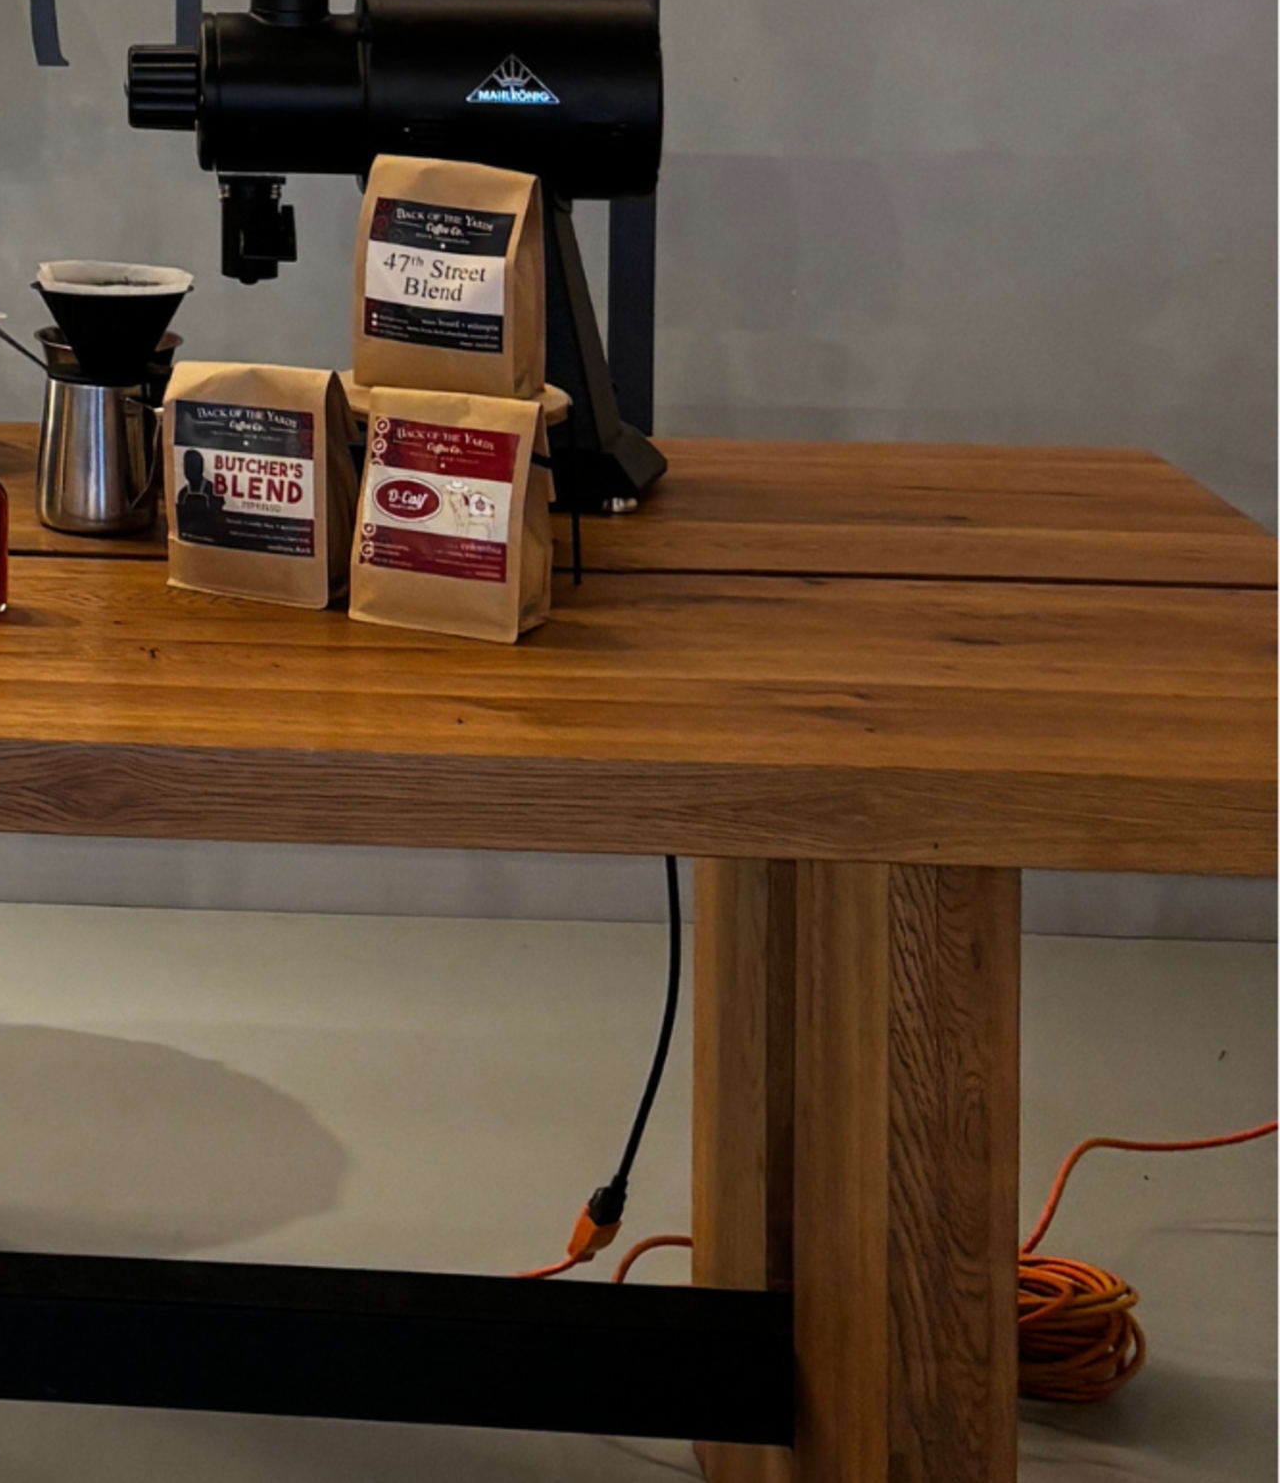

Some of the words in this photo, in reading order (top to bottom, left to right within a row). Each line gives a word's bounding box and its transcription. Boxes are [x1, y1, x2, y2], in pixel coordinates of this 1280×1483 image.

[383, 252, 425, 273] 47th
[430, 259, 486, 282] Street
[403, 276, 464, 302] Blend
[214, 455, 303, 479] BUTCHER'S
[214, 473, 304, 504] BLEND
